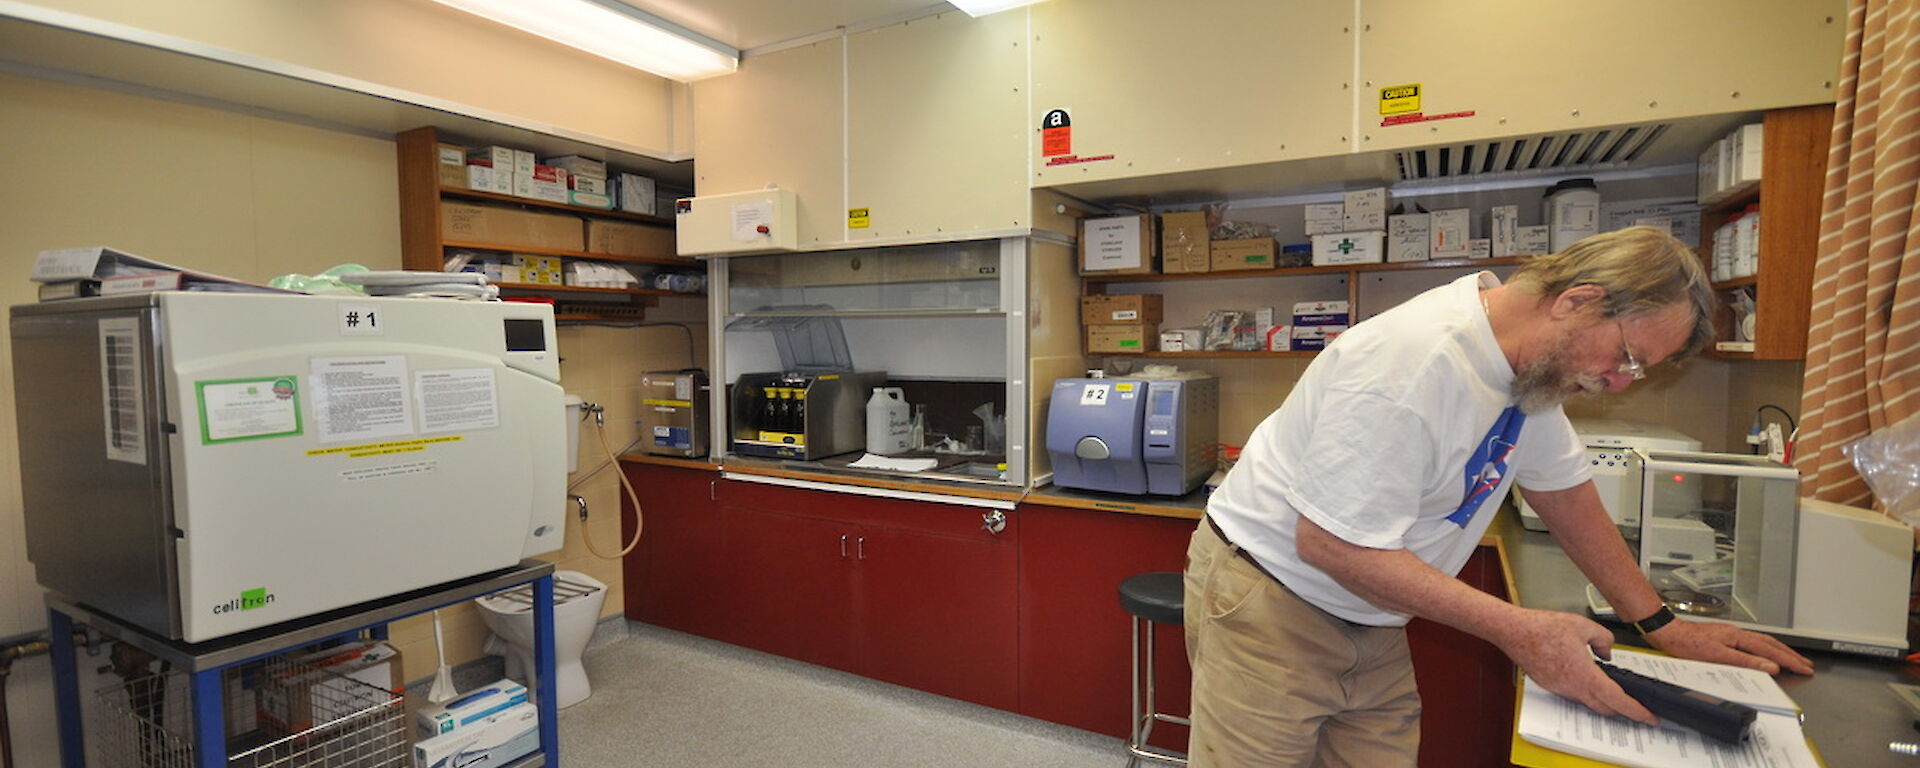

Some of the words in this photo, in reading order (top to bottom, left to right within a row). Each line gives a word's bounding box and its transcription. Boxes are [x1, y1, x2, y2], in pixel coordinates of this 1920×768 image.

[1050, 111, 1062, 126] a
[346, 312, 360, 327] #
[366, 312, 376, 327] 1
[1086, 389, 1094, 399] #
[1096, 389, 1105, 400] 2
[212, 593, 275, 615] celitron
